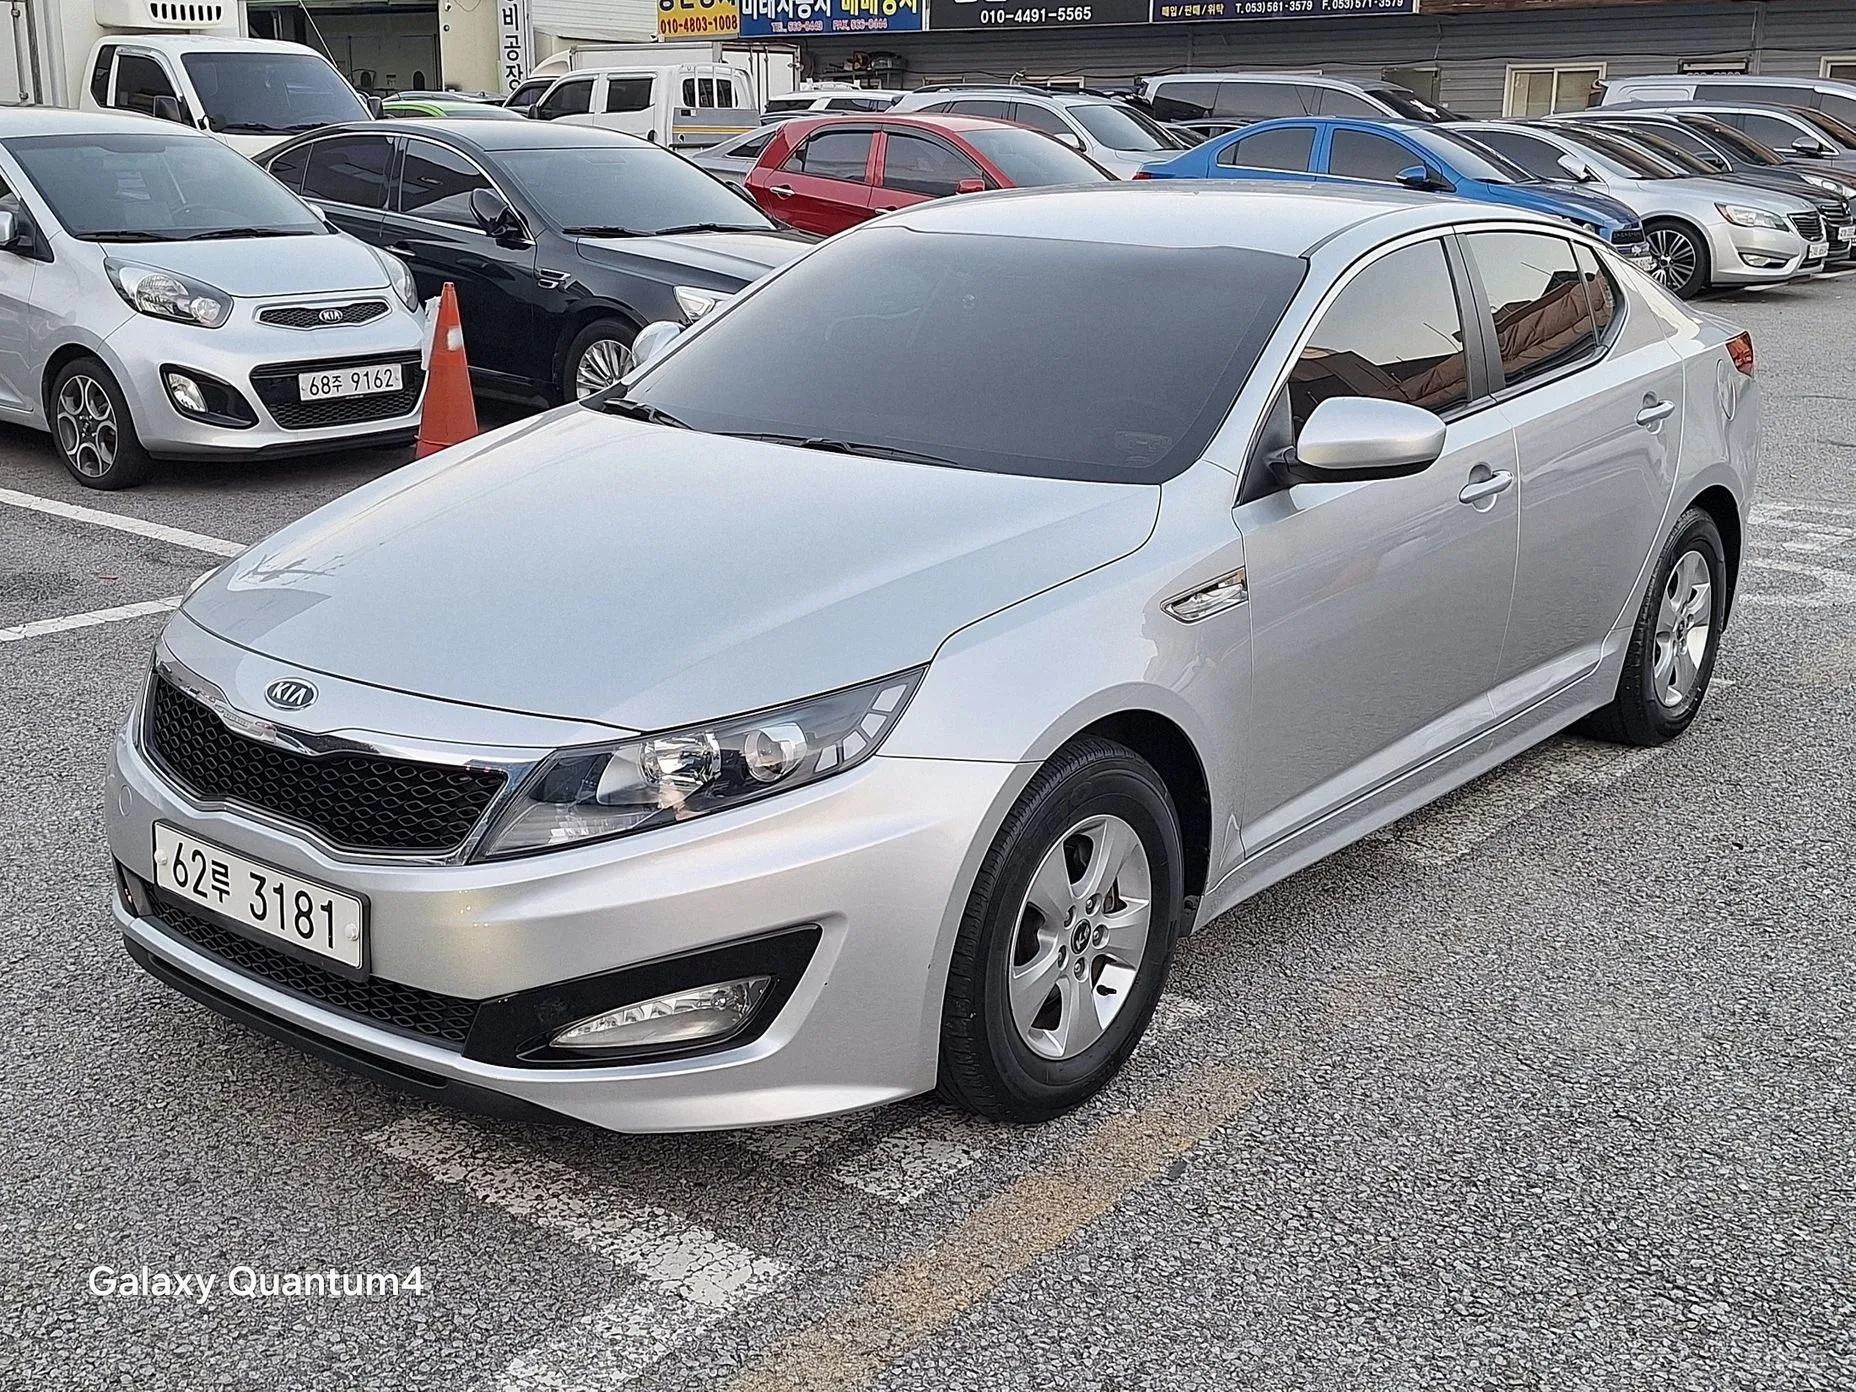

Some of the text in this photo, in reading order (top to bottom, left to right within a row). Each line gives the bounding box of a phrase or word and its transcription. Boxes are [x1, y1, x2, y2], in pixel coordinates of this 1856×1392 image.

[660, 14, 738, 34] 010-4803-1008
[980, 6, 1092, 24] 010-4491-5565
[501, 0, 523, 92] 비공장
[322, 310, 340, 321] KIA
[309, 368, 394, 396] 68주 9162
[271, 681, 310, 705] KIA
[172, 842, 335, 950] 62루 3181
